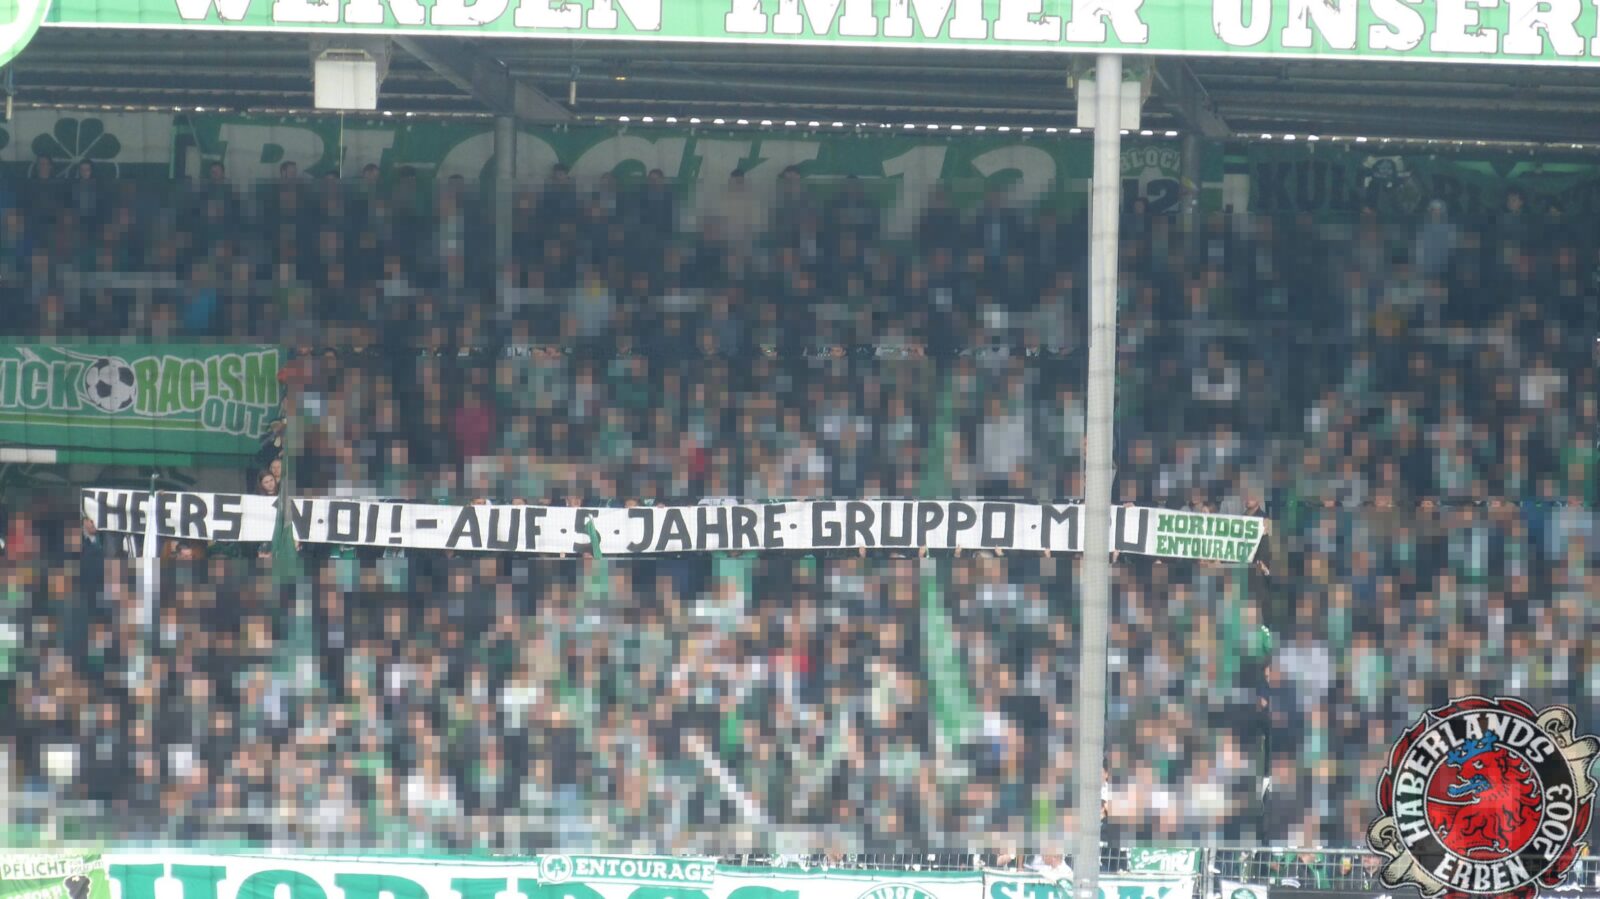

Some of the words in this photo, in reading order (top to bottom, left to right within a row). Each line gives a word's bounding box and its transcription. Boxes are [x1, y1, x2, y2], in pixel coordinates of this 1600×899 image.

[1212, 0, 1600, 57] UNSER
[0, 357, 84, 411] ICK
[131, 349, 279, 416] RACISM
[201, 396, 267, 439] OUT
[445, 505, 548, 552] AUF
[626, 503, 787, 552] JAHRE
[811, 501, 1016, 548] GRUPPO
[1040, 504, 1150, 553] MU
[1157, 514, 1260, 541] HORIDOS
[3, 860, 66, 877] PFLICHT
[575, 859, 715, 881] ENTOURAGE
